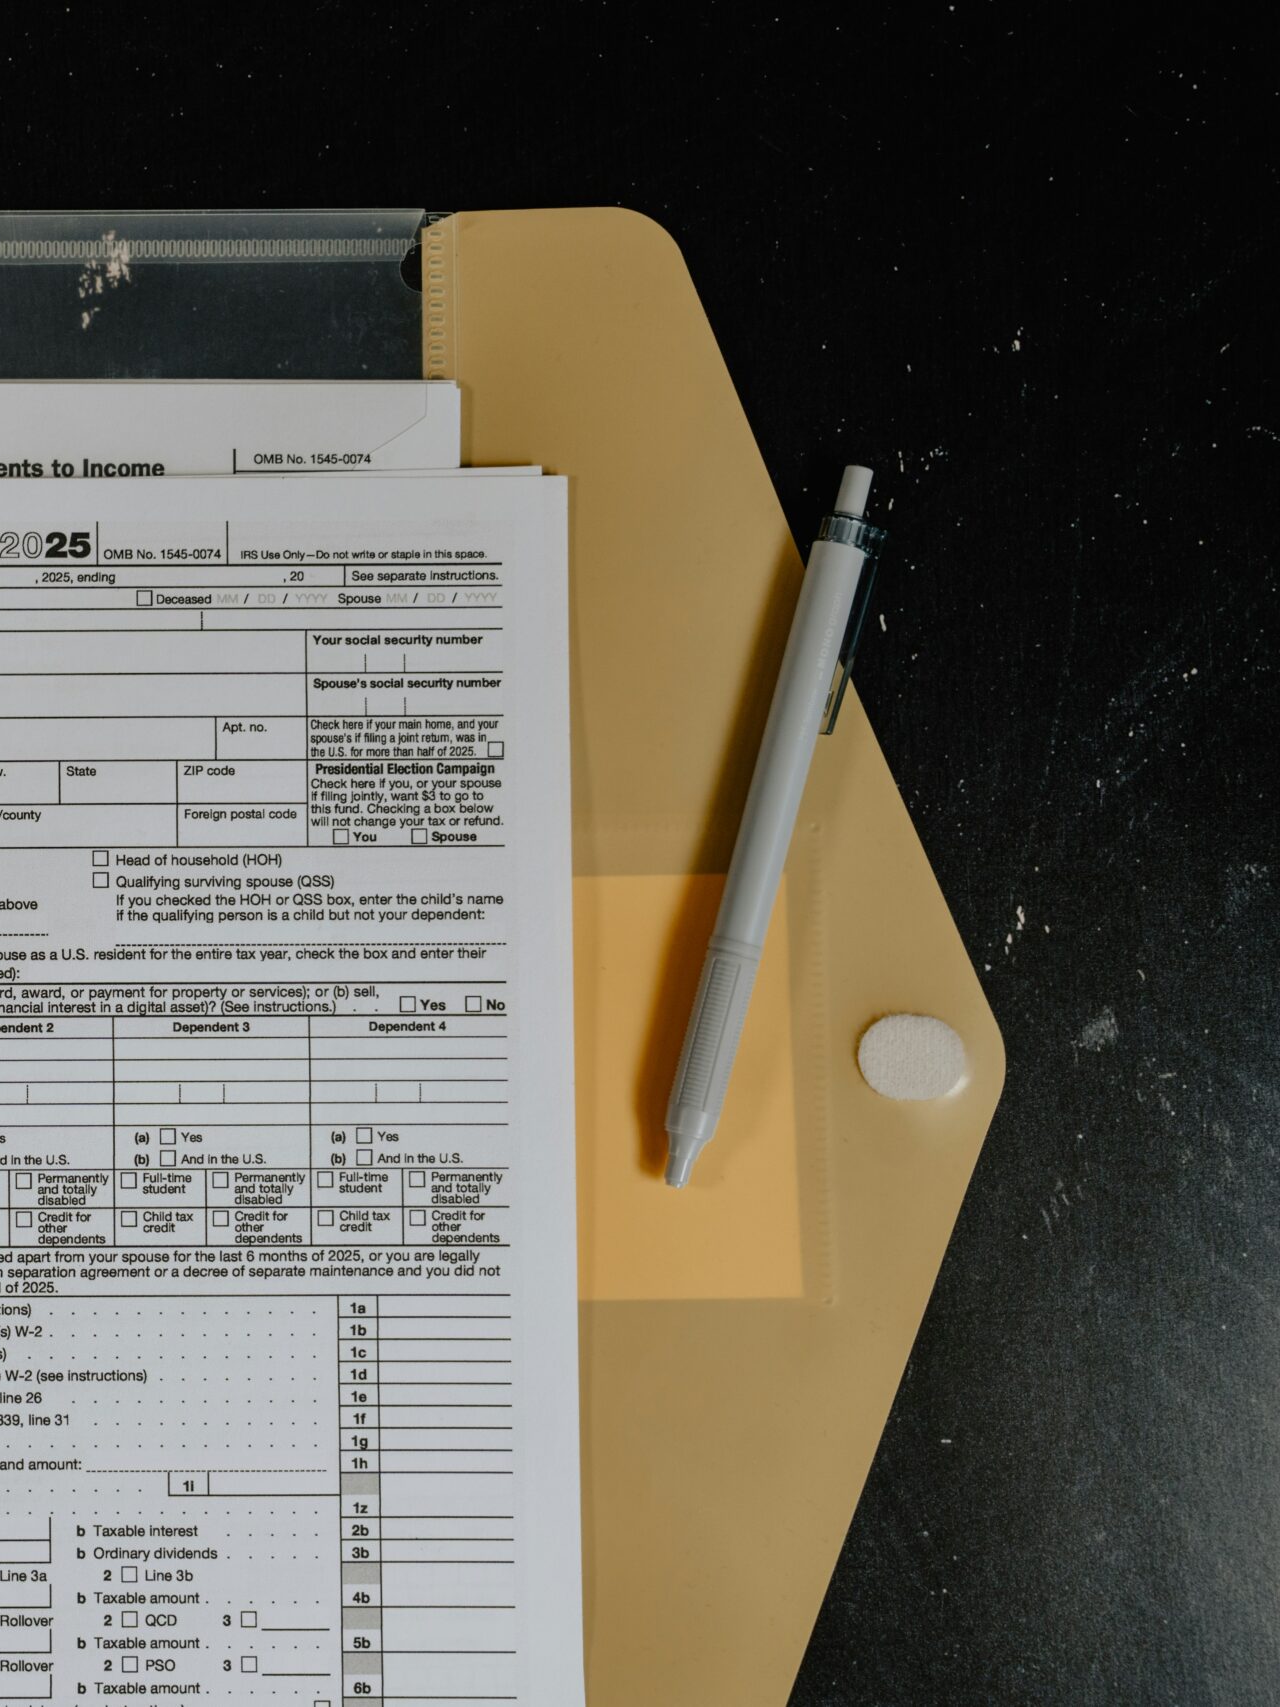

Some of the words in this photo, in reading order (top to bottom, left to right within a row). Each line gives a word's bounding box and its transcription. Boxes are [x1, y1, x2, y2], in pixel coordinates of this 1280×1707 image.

[254, 453, 283, 465] OMB
[287, 454, 306, 464] No.
[311, 454, 371, 464] 1545-0074
[51, 459, 74, 477] to
[82, 458, 165, 477] Income
[0, 532, 91, 559] 2025
[103, 549, 133, 560] OMB
[137, 549, 156, 560] No.
[161, 549, 221, 560] 1545-0074
[241, 550, 258, 560] IRS
[261, 550, 281, 560] Use
[333, 550, 349, 559] not
[351, 550, 376, 559] write
[391, 550, 421, 560] staple
[423, 550, 432, 558] in
[434, 550, 452, 559] this
[455, 551, 488, 561] space.
[42, 572, 73, 584] 2025,
[77, 572, 116, 585] ending
[290, 571, 304, 582] 20
[352, 570, 374, 581] See
[377, 571, 427, 583] separate
[430, 570, 499, 581] instructions.
[156, 594, 212, 605] Deceased
[217, 594, 239, 604] MM
[257, 593, 276, 604] DD
[295, 593, 328, 603] YYYY
[338, 593, 381, 606] Spouse
[313, 635, 342, 645] Your
[345, 635, 381, 645] social
[384, 634, 433, 647] security
[436, 634, 483, 645] number
[313, 678, 367, 691] Spouse's
[370, 678, 404, 689] social
[407, 678, 454, 690] security
[456, 677, 501, 688] number
[222, 722, 246, 734] Apt.
[249, 724, 267, 732] no.
[66, 766, 96, 777] State
[184, 765, 204, 776] ZIP
[207, 765, 235, 776] code
[315, 763, 384, 775] Presidential
[387, 762, 433, 775] Election
[436, 762, 495, 777] Campaign
[353, 832, 377, 842] You
[431, 831, 477, 844] Spouse
[116, 854, 150, 866] Head
[154, 854, 167, 866] of
[171, 854, 238, 866] household
[243, 853, 282, 868] (HOH)
[116, 875, 180, 890] Qualifying
[184, 876, 241, 890] surviving
[246, 878, 293, 890] spouse
[297, 875, 334, 890] (QSS)
[420, 999, 446, 1011] Yes
[486, 999, 505, 1011] No
[46, 1022, 54, 1033] 2
[173, 1022, 239, 1035] Dependent
[242, 1022, 250, 1032] 3
[369, 1021, 435, 1034] Dependent
[438, 1021, 446, 1031] 4
[235, 1172, 306, 1184] Permanently
[234, 1183, 255, 1196] and
[258, 1183, 294, 1196] totally
[350, 1302, 366, 1314] 1a
[350, 1324, 367, 1336] 1b
[351, 1435, 368, 1449] 1g
[352, 1457, 368, 1469] 1h
[183, 1480, 194, 1492] 1i
[353, 1502, 368, 1514] 1z
[76, 1525, 86, 1537] b
[93, 1525, 145, 1537] Taxable
[149, 1525, 198, 1537] interest
[352, 1524, 369, 1536] 2b
[77, 1547, 86, 1559] b
[93, 1547, 150, 1562] Ordinary
[154, 1547, 218, 1559] dividends
[352, 1547, 370, 1559] 3b
[352, 1592, 370, 1604] 4b
[0, 1615, 54, 1627] Rollover
[145, 1614, 177, 1627] QCD
[353, 1637, 371, 1649] 5b
[0, 1660, 54, 1672] Rollover
[146, 1659, 176, 1672] PSO
[353, 1682, 371, 1694] 6b
